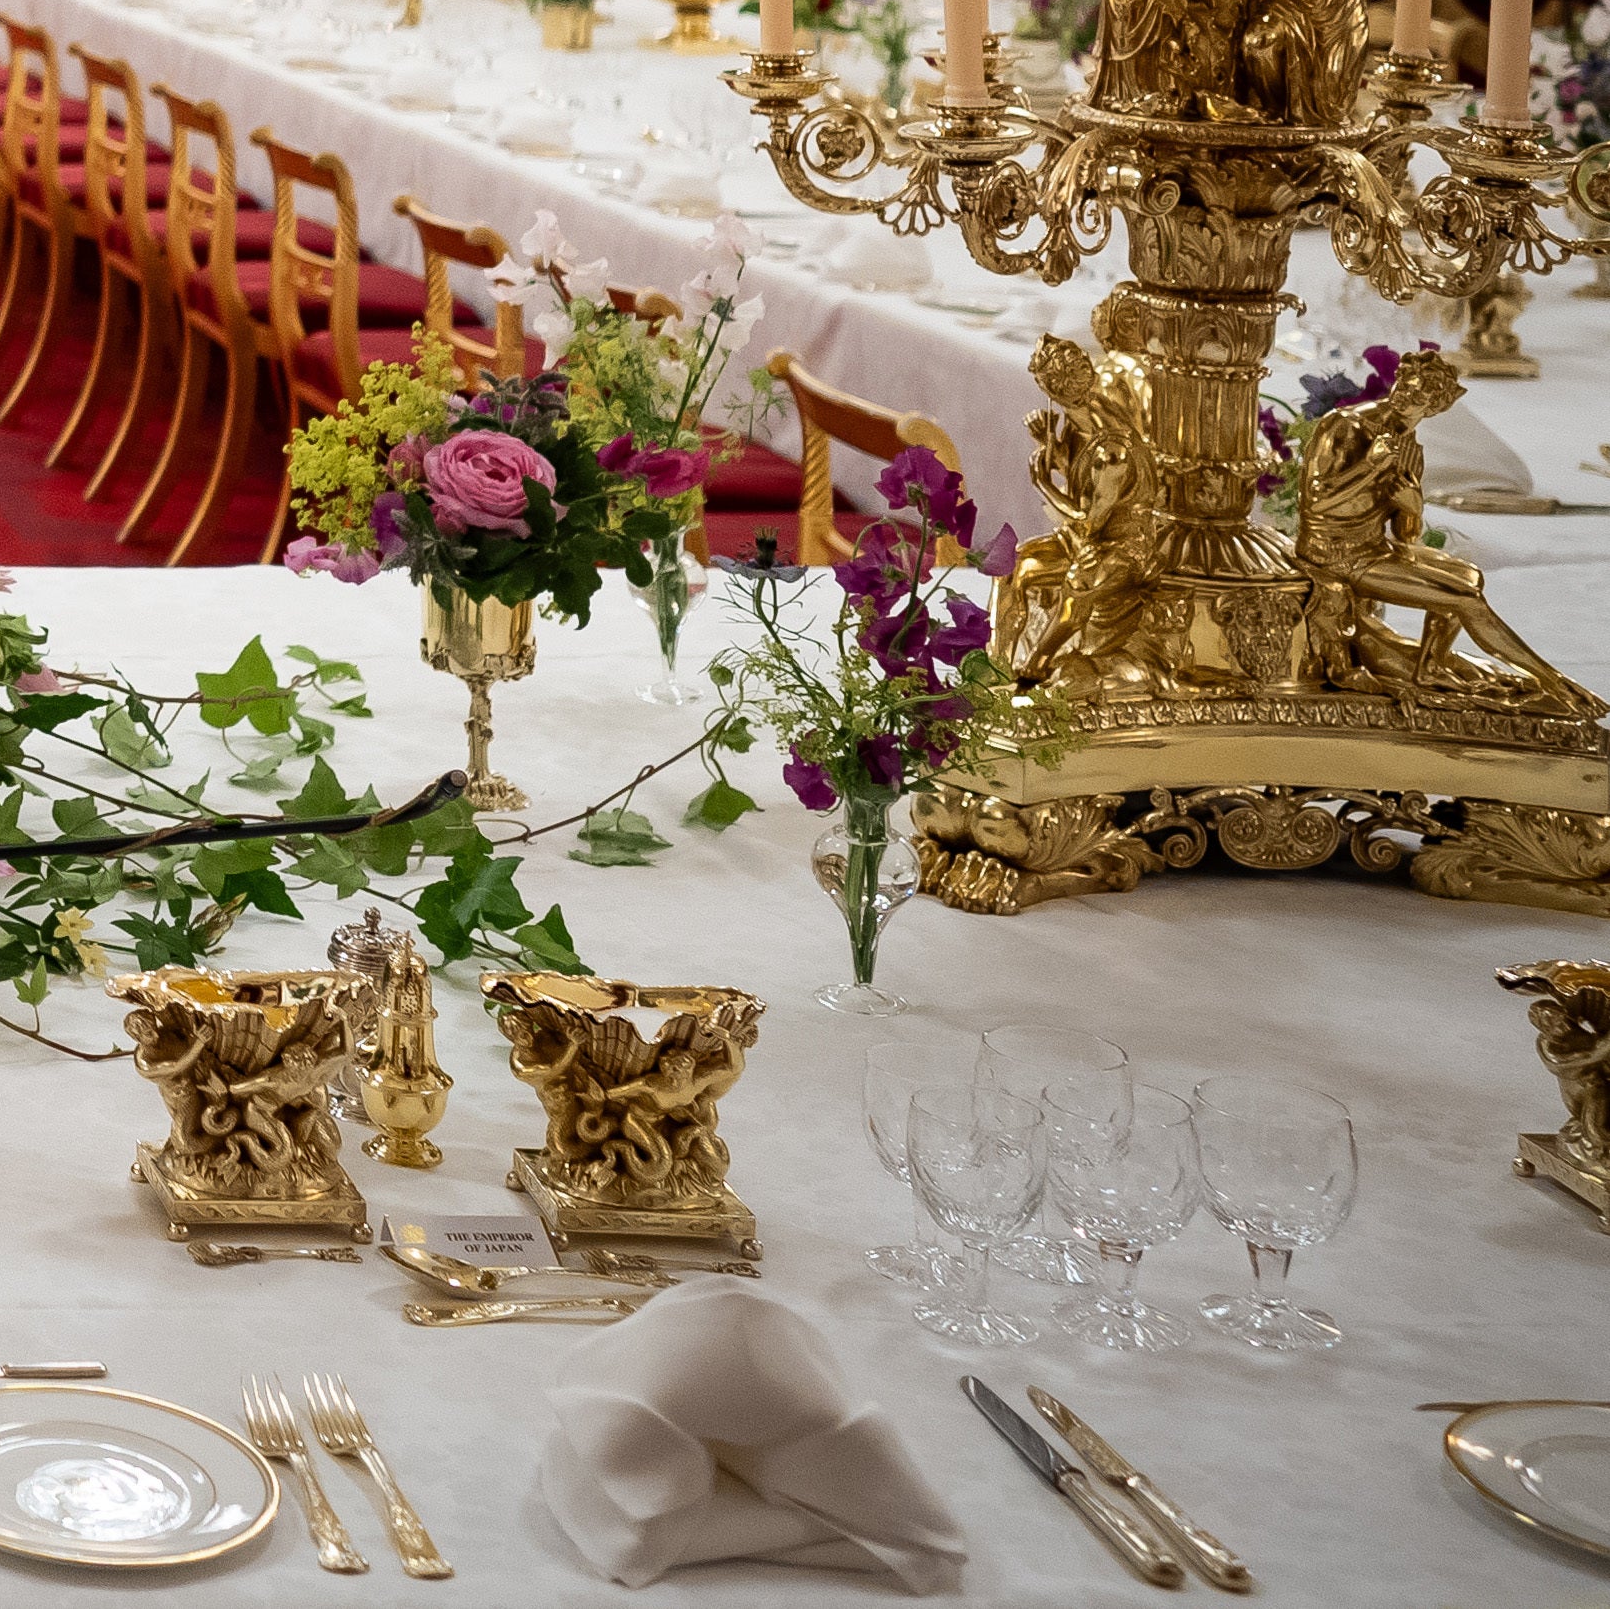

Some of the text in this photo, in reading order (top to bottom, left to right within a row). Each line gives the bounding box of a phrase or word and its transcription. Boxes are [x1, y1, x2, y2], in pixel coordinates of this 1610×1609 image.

[445, 1233, 535, 1242] THE EMPEROR
[464, 1244, 524, 1253] OF JAPAN
